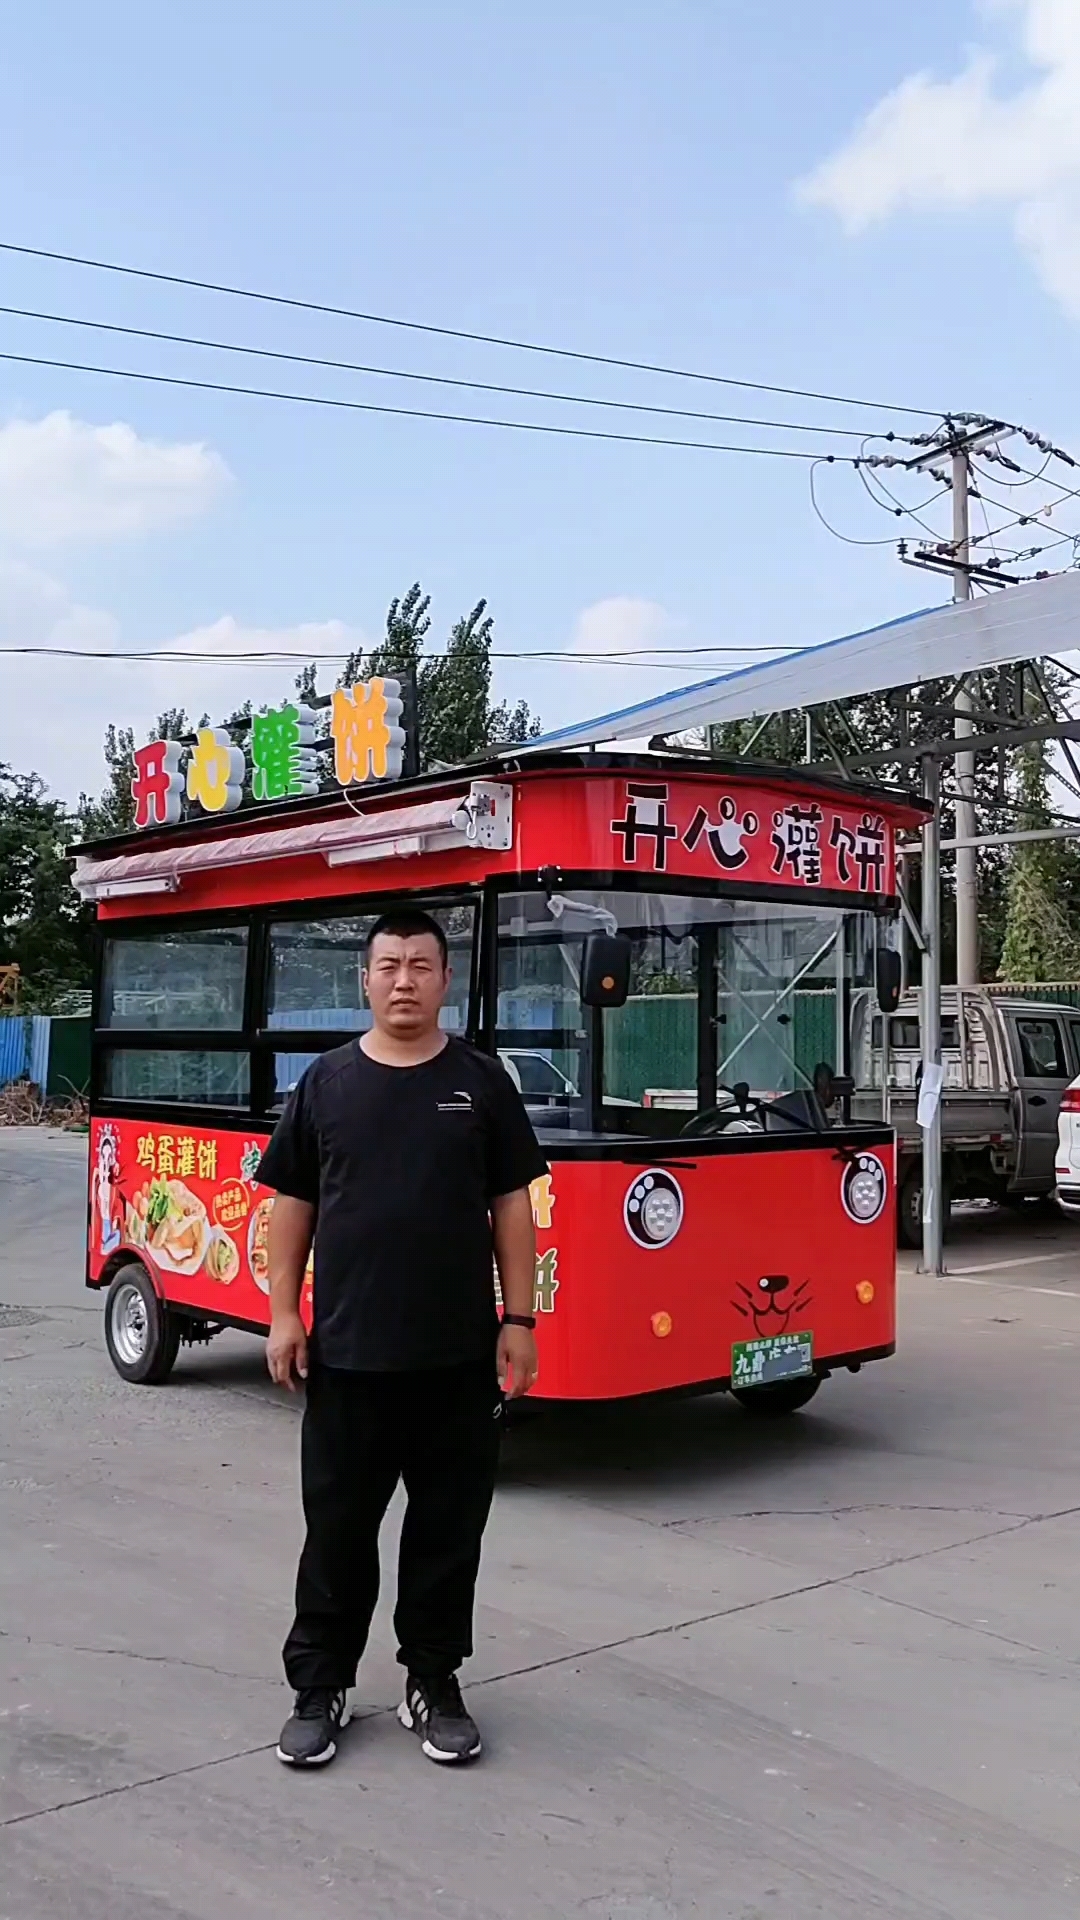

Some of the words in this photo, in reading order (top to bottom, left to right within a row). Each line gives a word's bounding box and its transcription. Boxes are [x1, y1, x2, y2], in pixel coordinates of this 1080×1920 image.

[131, 676, 391, 828] 开心灌饼
[610, 782, 885, 892] 开心灌饼
[136, 1132, 217, 1180] 鸡蛋灌饼
